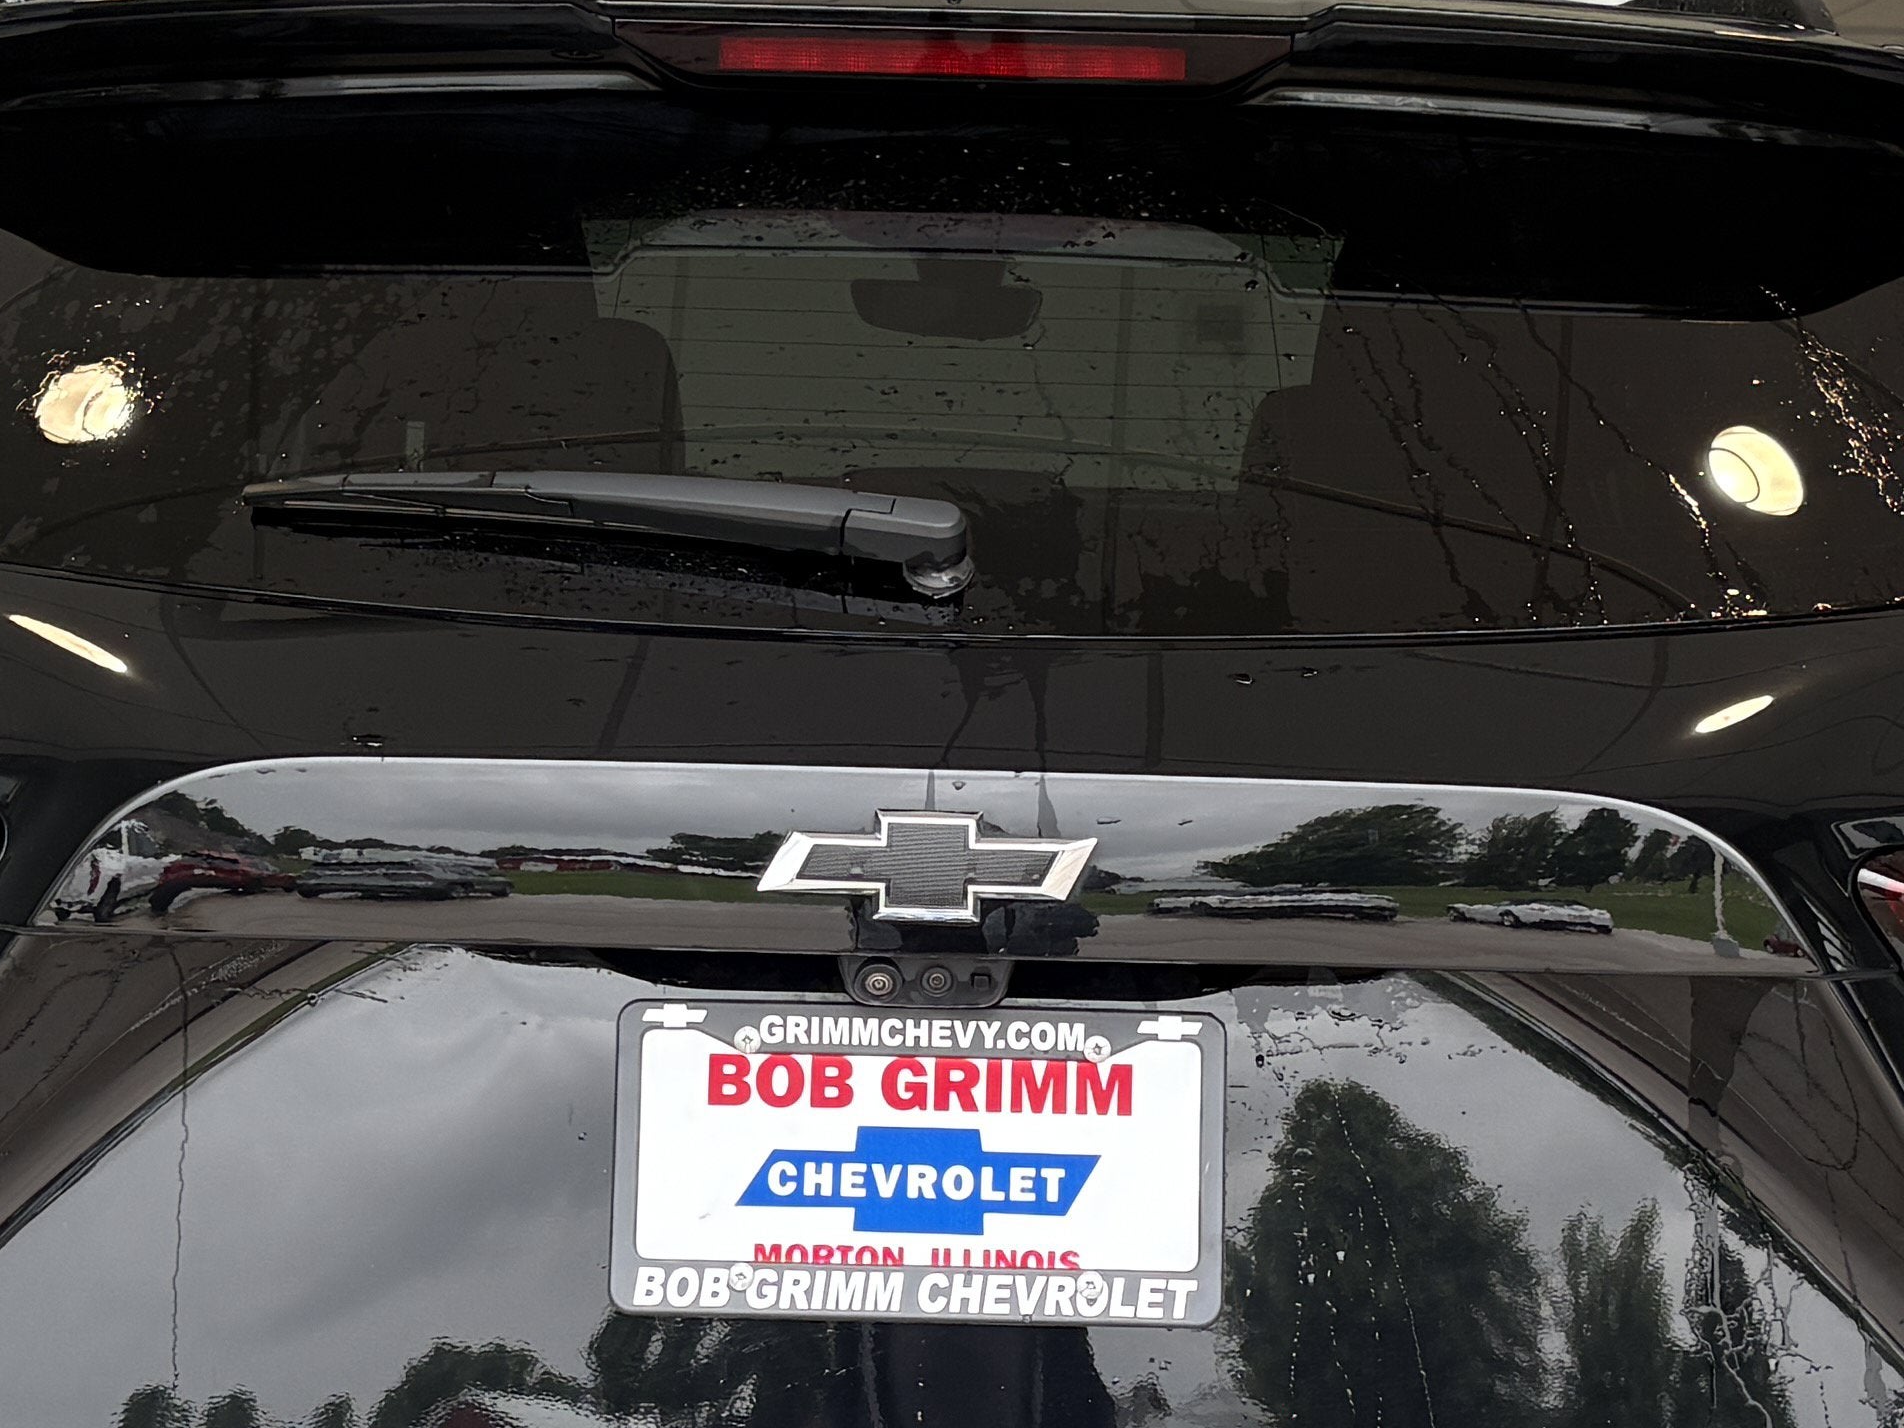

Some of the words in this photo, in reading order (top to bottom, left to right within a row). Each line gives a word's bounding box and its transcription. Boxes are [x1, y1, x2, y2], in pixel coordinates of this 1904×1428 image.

[757, 1015, 1085, 1052] GRIMMCHEVY.COM
[707, 1053, 854, 1109] BOB
[881, 1056, 1133, 1117] GRIMM
[766, 1160, 1066, 1203] CHEVROLET
[632, 1266, 732, 1309] BOB
[745, 1268, 904, 1312] GRIMM
[916, 1272, 1198, 1320] CHEVROLET
